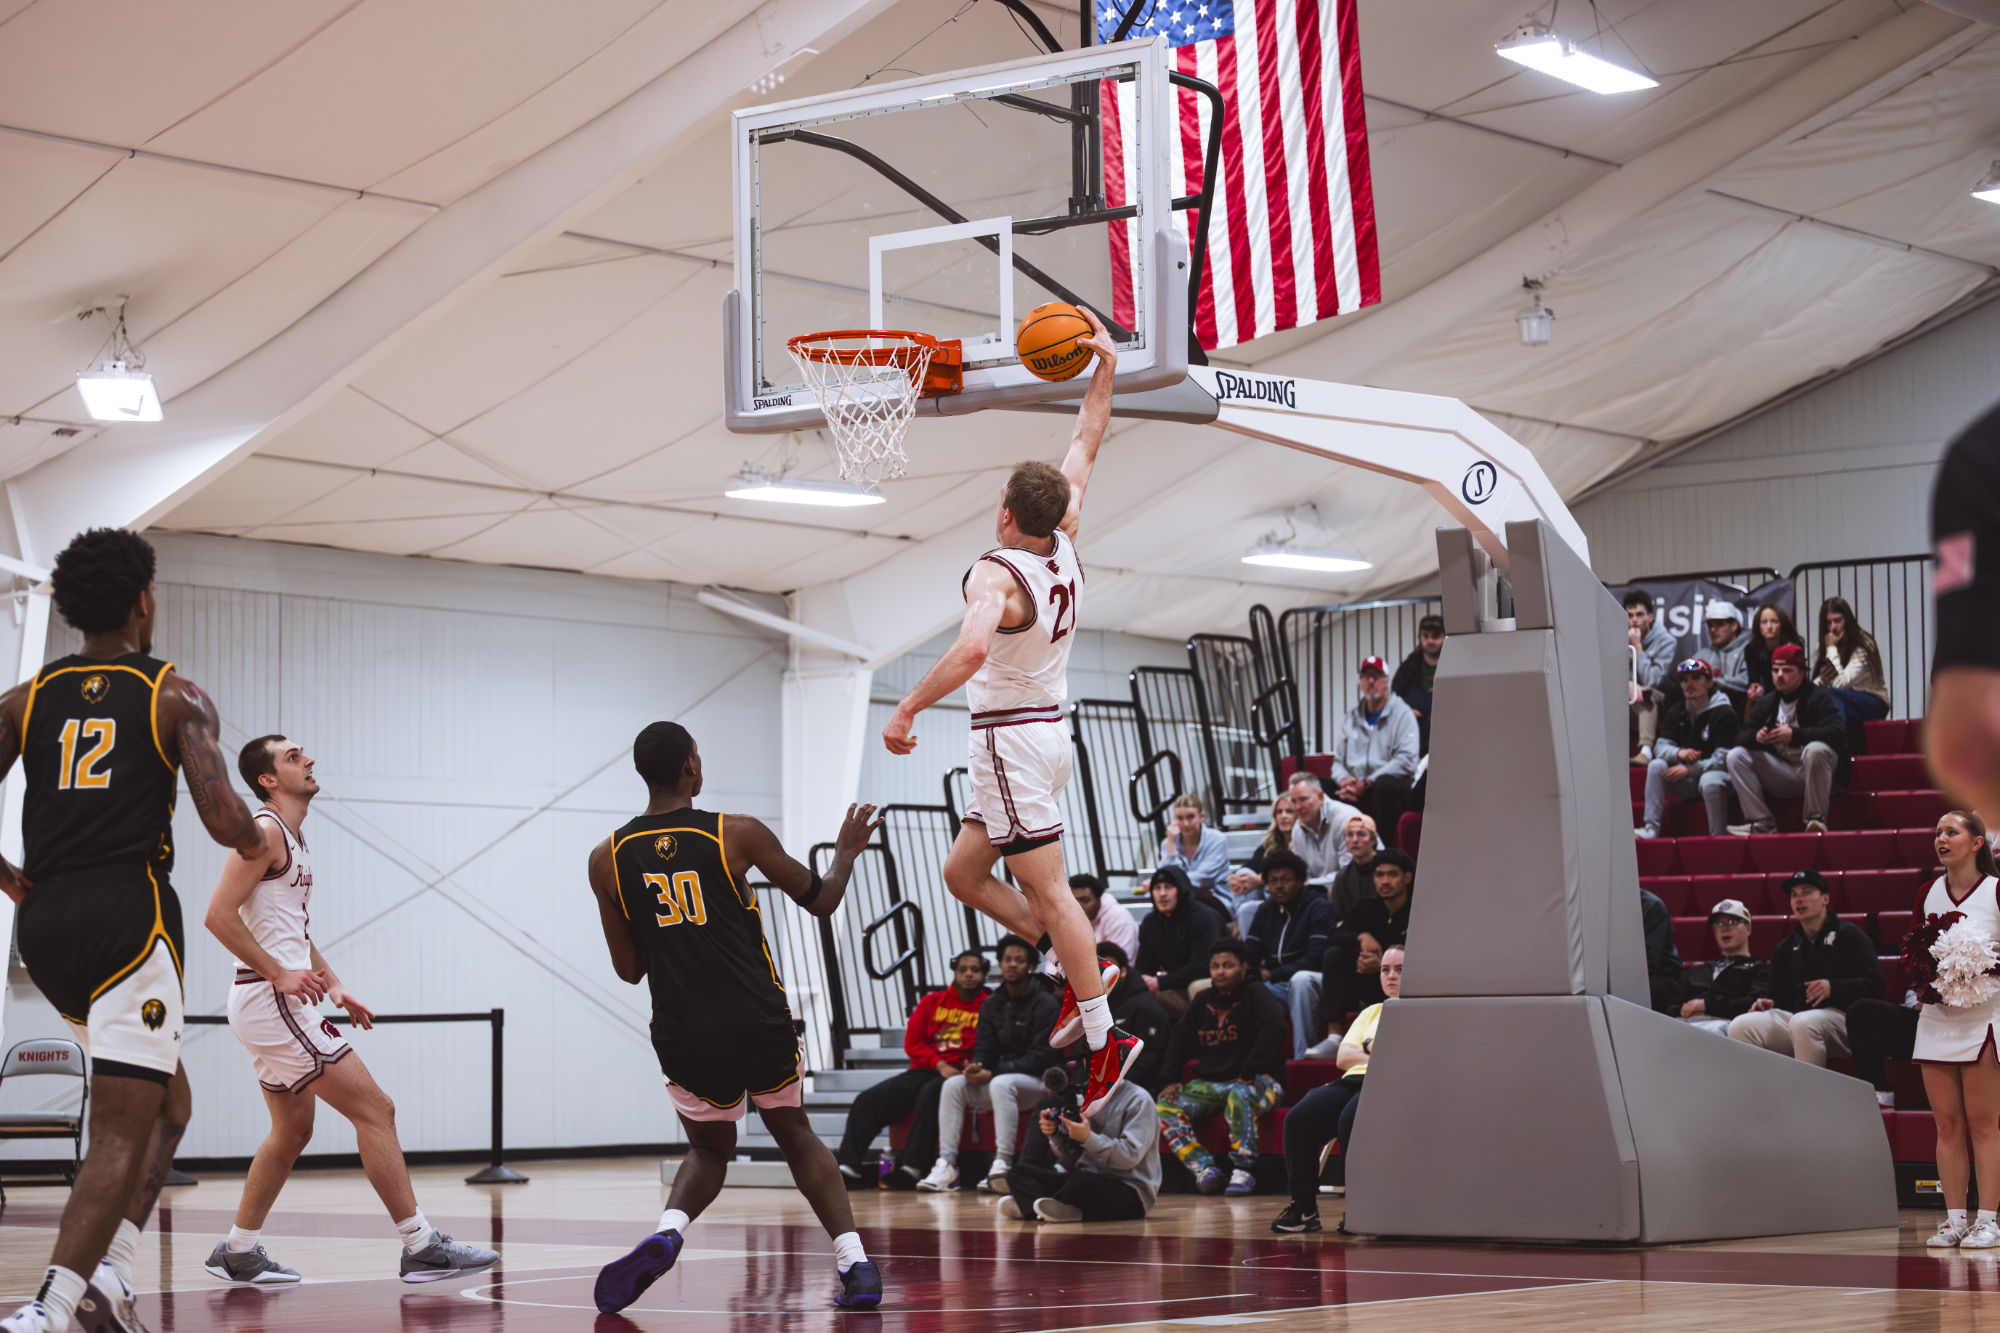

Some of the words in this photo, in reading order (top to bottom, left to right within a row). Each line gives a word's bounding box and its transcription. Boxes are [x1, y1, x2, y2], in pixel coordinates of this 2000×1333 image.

[1030, 346, 1084, 371] Wilson
[753, 394, 792, 411] SPALDING
[1215, 370, 1296, 410] SPALDING
[1049, 577, 1076, 644] 21
[58, 717, 116, 790] 12
[642, 870, 707, 928] 30
[18, 1050, 70, 1062] KNIGHTS
